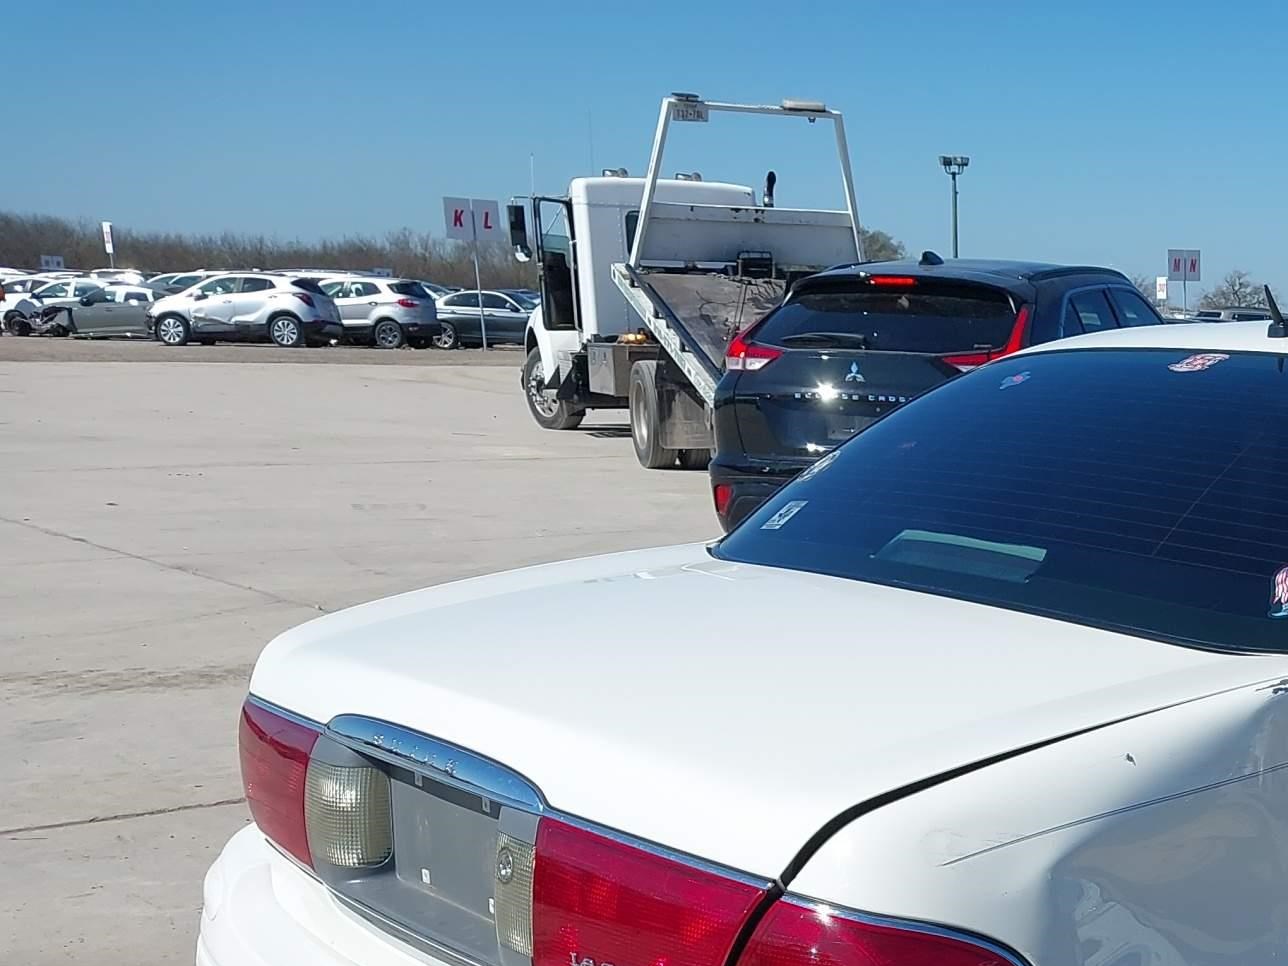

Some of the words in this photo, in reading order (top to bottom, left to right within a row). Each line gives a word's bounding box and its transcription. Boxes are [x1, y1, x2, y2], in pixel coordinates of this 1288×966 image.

[454, 209, 464, 227] K
[484, 211, 493, 229] L
[1190, 258, 1197, 272] N
[373, 735, 459, 774] BUICK
